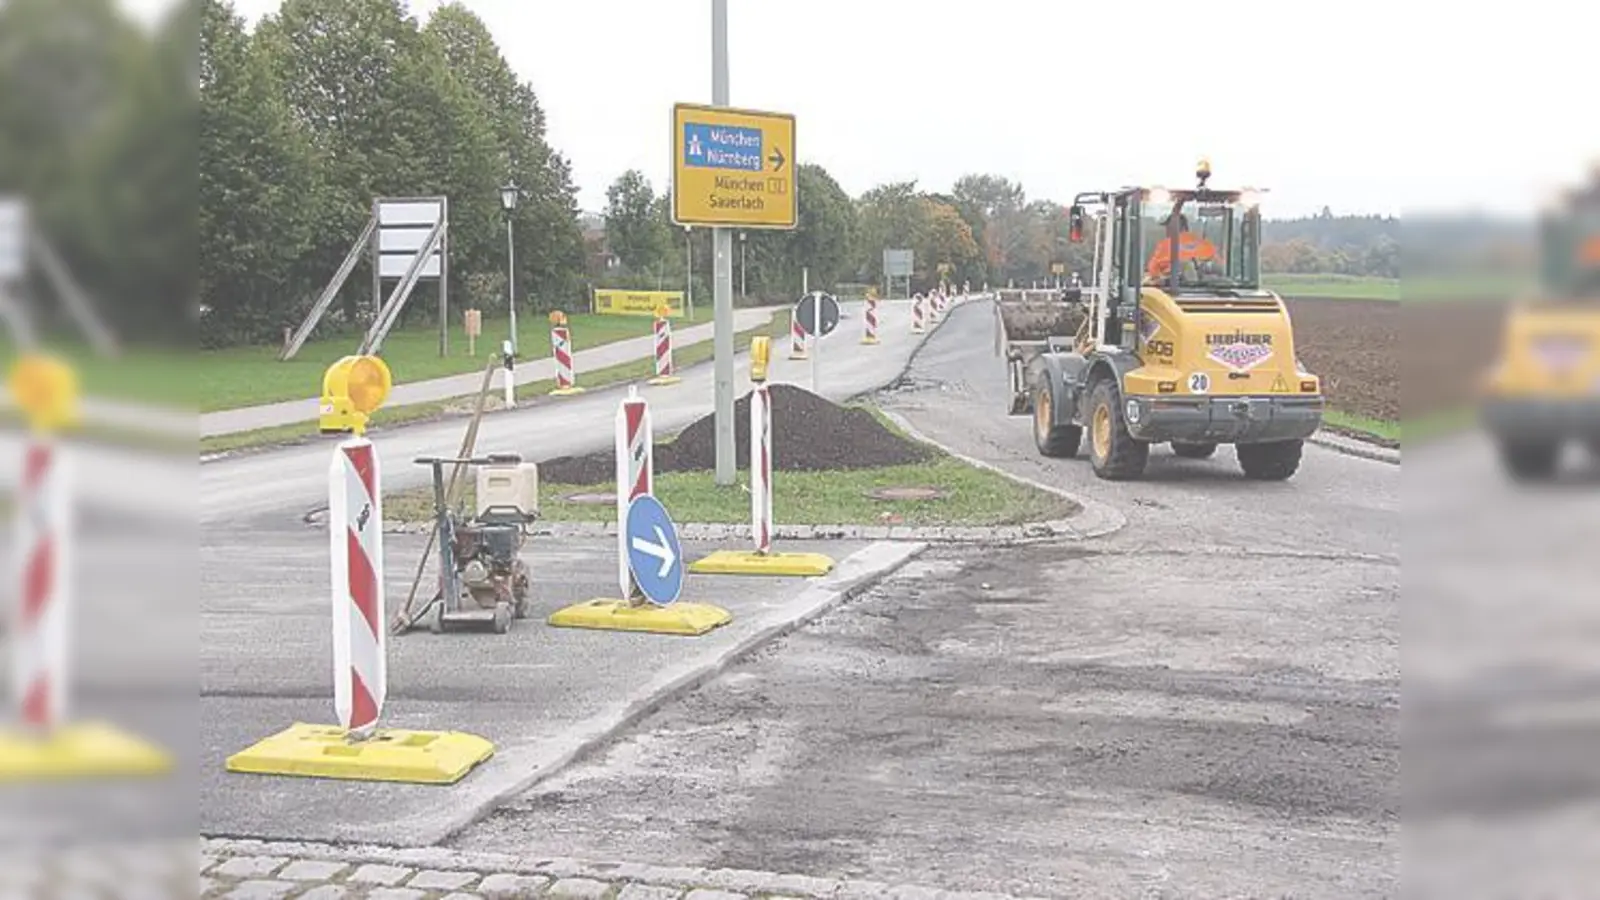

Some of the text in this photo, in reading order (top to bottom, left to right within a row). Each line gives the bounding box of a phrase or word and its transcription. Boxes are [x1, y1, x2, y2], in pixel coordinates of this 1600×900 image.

[711, 128, 760, 147] München
[707, 147, 760, 170] Nürnberg
[715, 176, 764, 192] München
[709, 194, 764, 210] Sauerlach
[1191, 374, 1208, 391] 20
